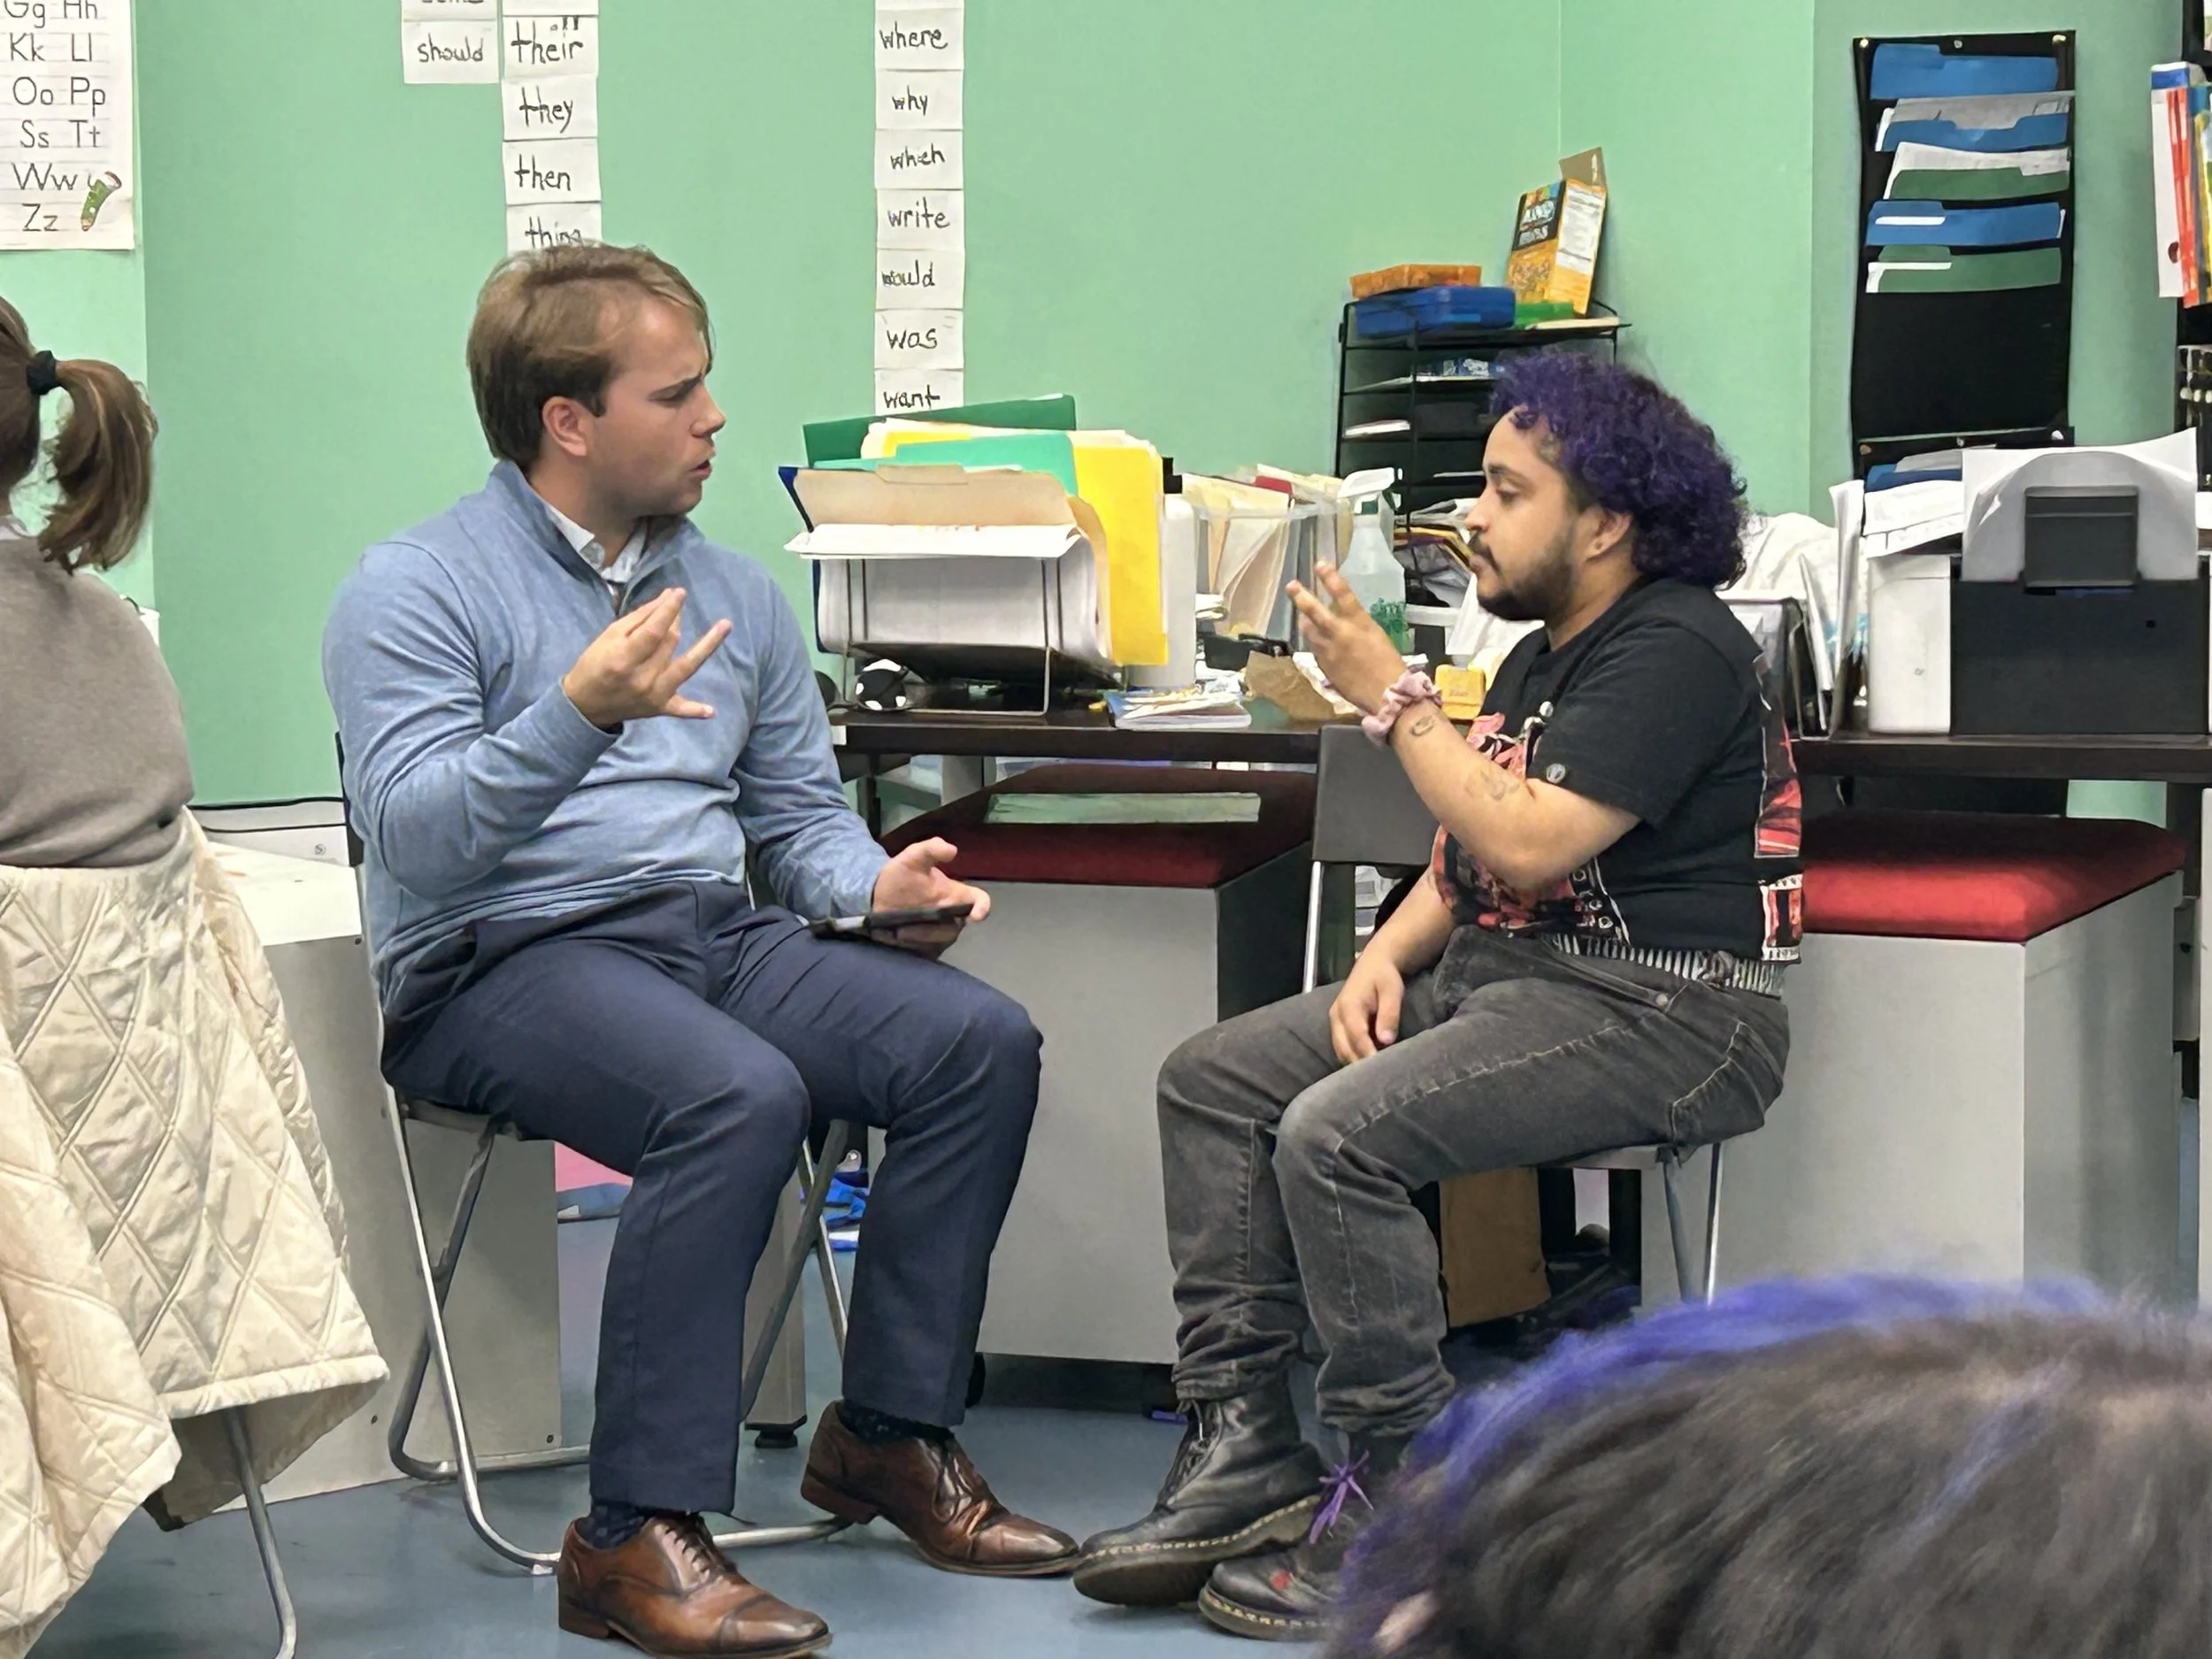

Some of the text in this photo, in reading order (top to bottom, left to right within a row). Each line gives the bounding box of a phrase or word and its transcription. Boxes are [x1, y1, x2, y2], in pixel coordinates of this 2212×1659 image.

[4, 0, 45, 28] Gg
[10, 32, 93, 62] Kk Ll
[418, 33, 483, 63] should
[511, 20, 583, 65] their
[879, 20, 949, 50] where
[12, 76, 106, 118] Oo Pp
[518, 86, 573, 134] they
[892, 84, 928, 116] why
[19, 119, 101, 149] Ss Tt
[11, 162, 78, 191] Ww
[513, 152, 571, 191] then
[21, 203, 59, 233] Zz
[887, 196, 950, 229] write
[886, 327, 938, 349] was
[883, 384, 941, 410] want
